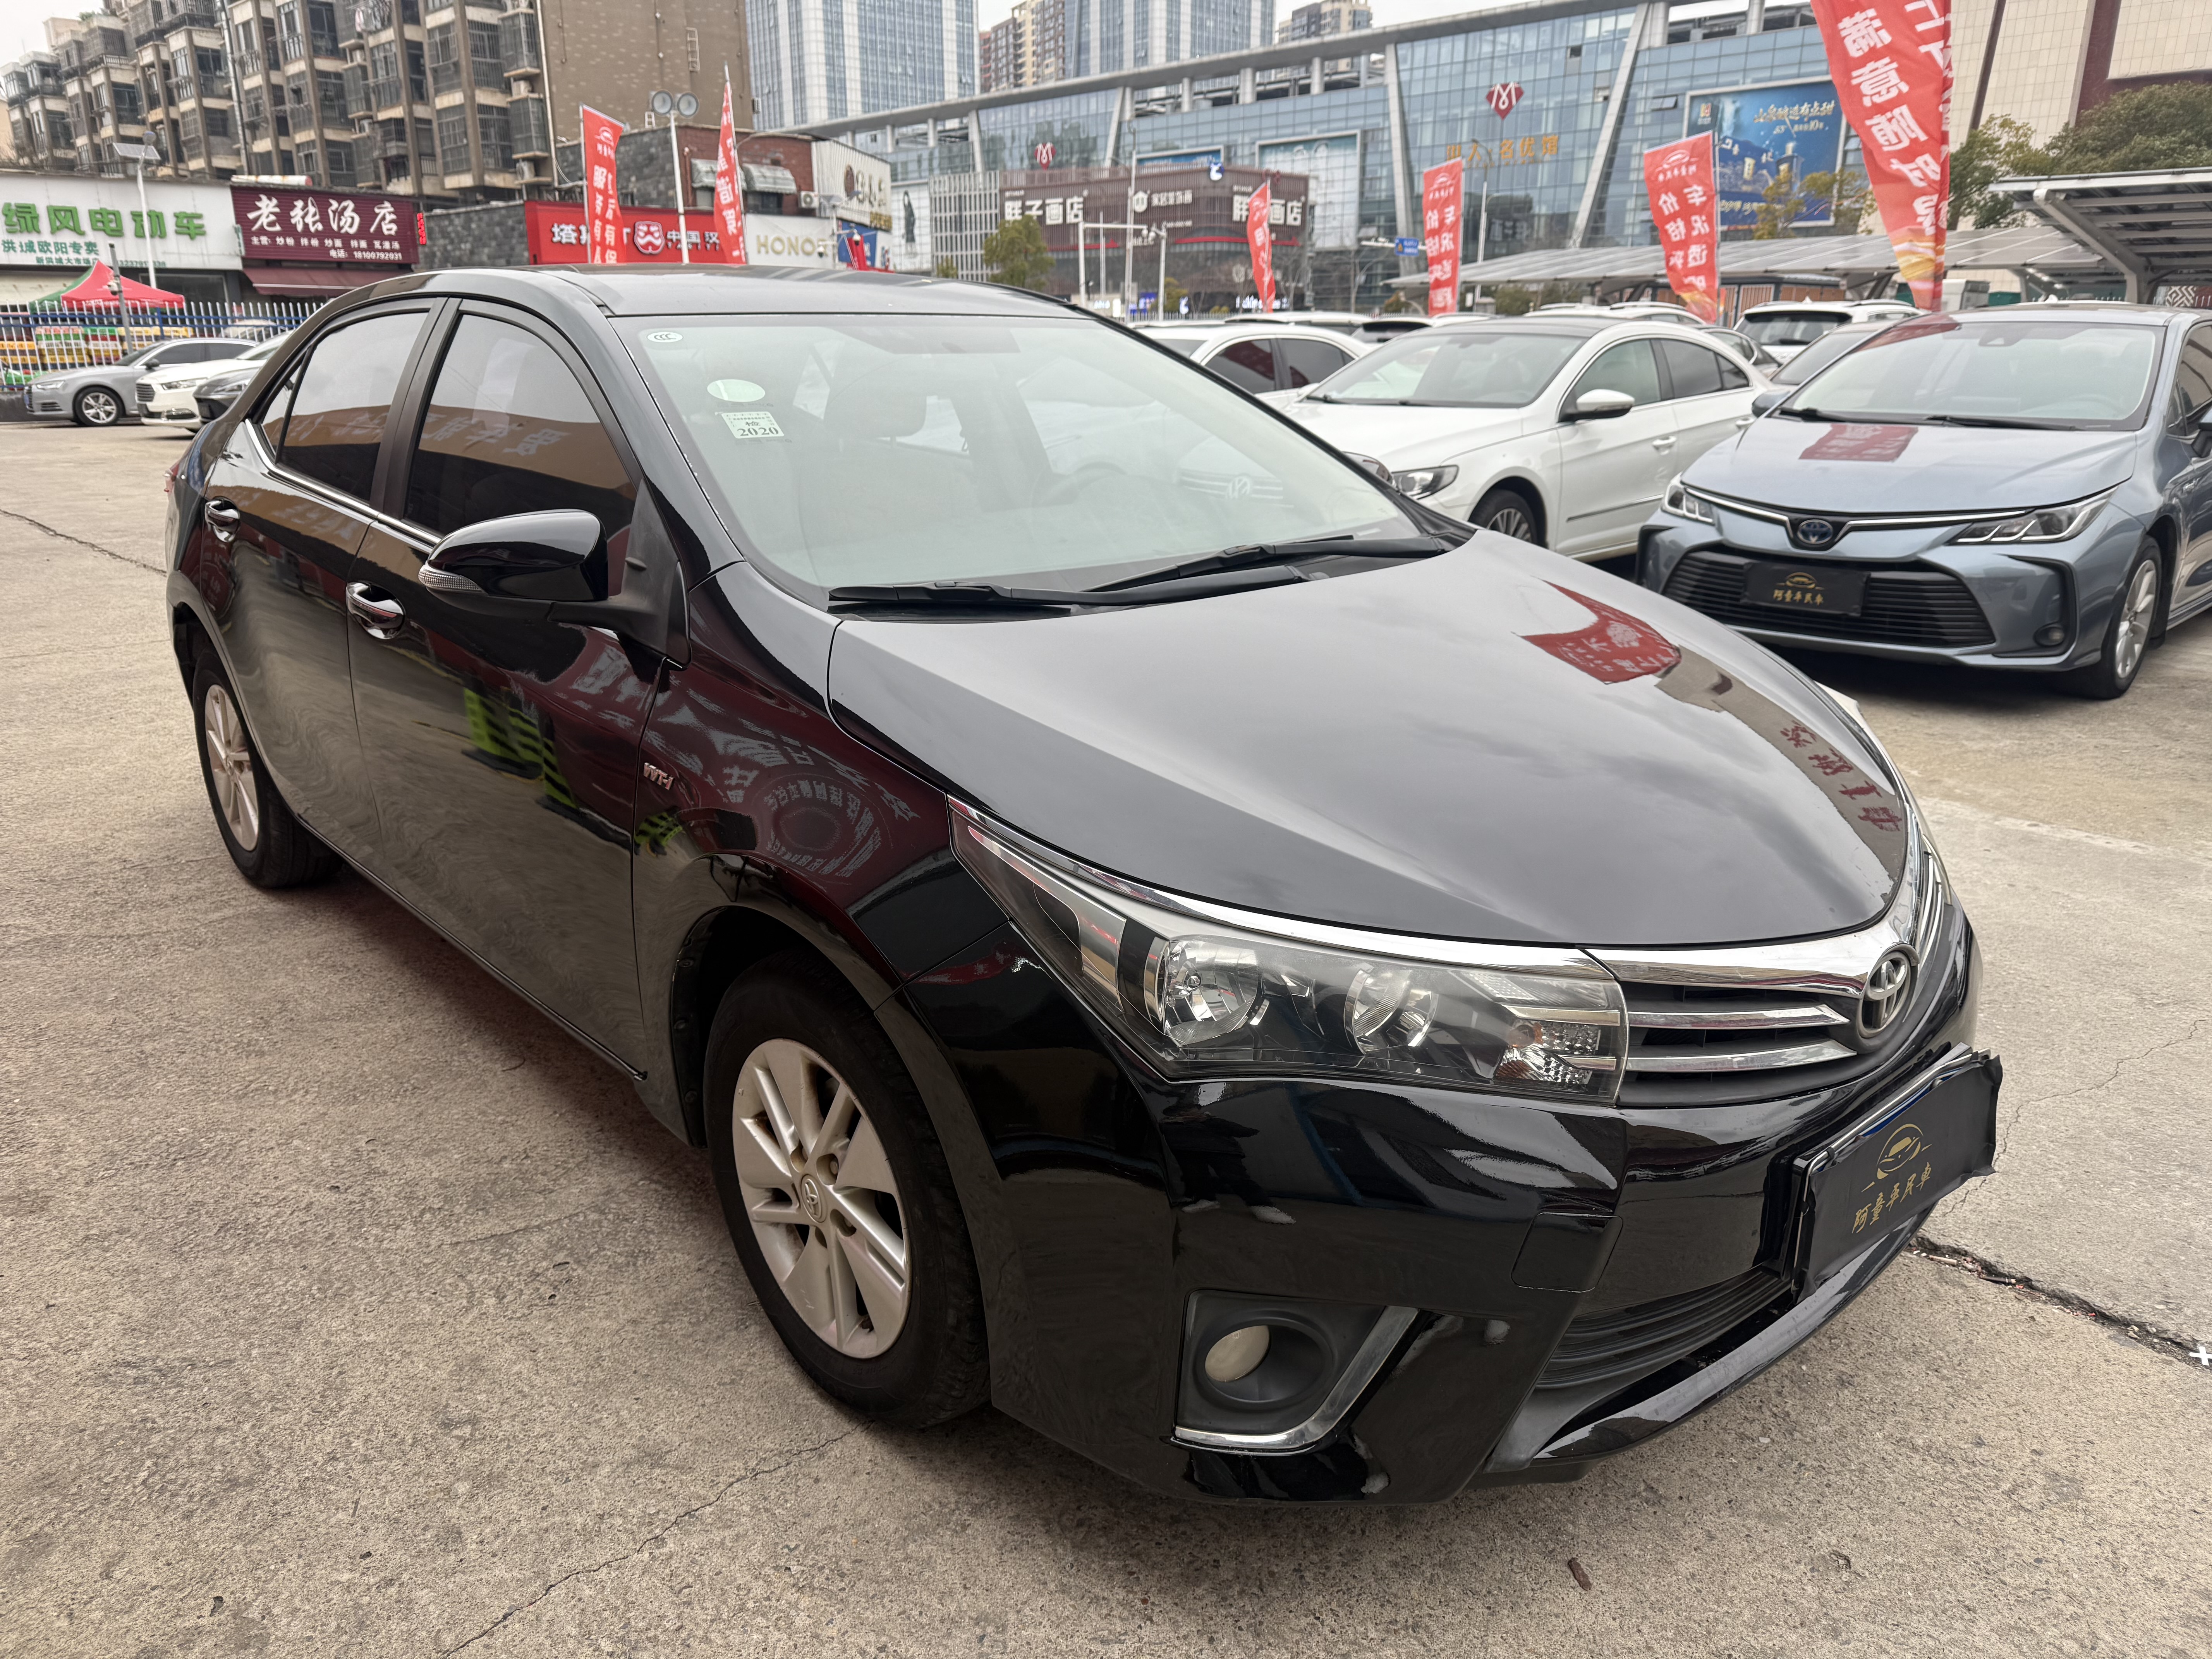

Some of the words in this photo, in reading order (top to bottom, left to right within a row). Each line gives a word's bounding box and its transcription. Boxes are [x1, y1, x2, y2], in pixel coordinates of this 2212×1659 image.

[2, 202, 207, 241] 绿风电动车
[247, 194, 401, 236] 老张汤店
[1233, 194, 1302, 226] 胖画店
[737, 427, 779, 436] 2020
